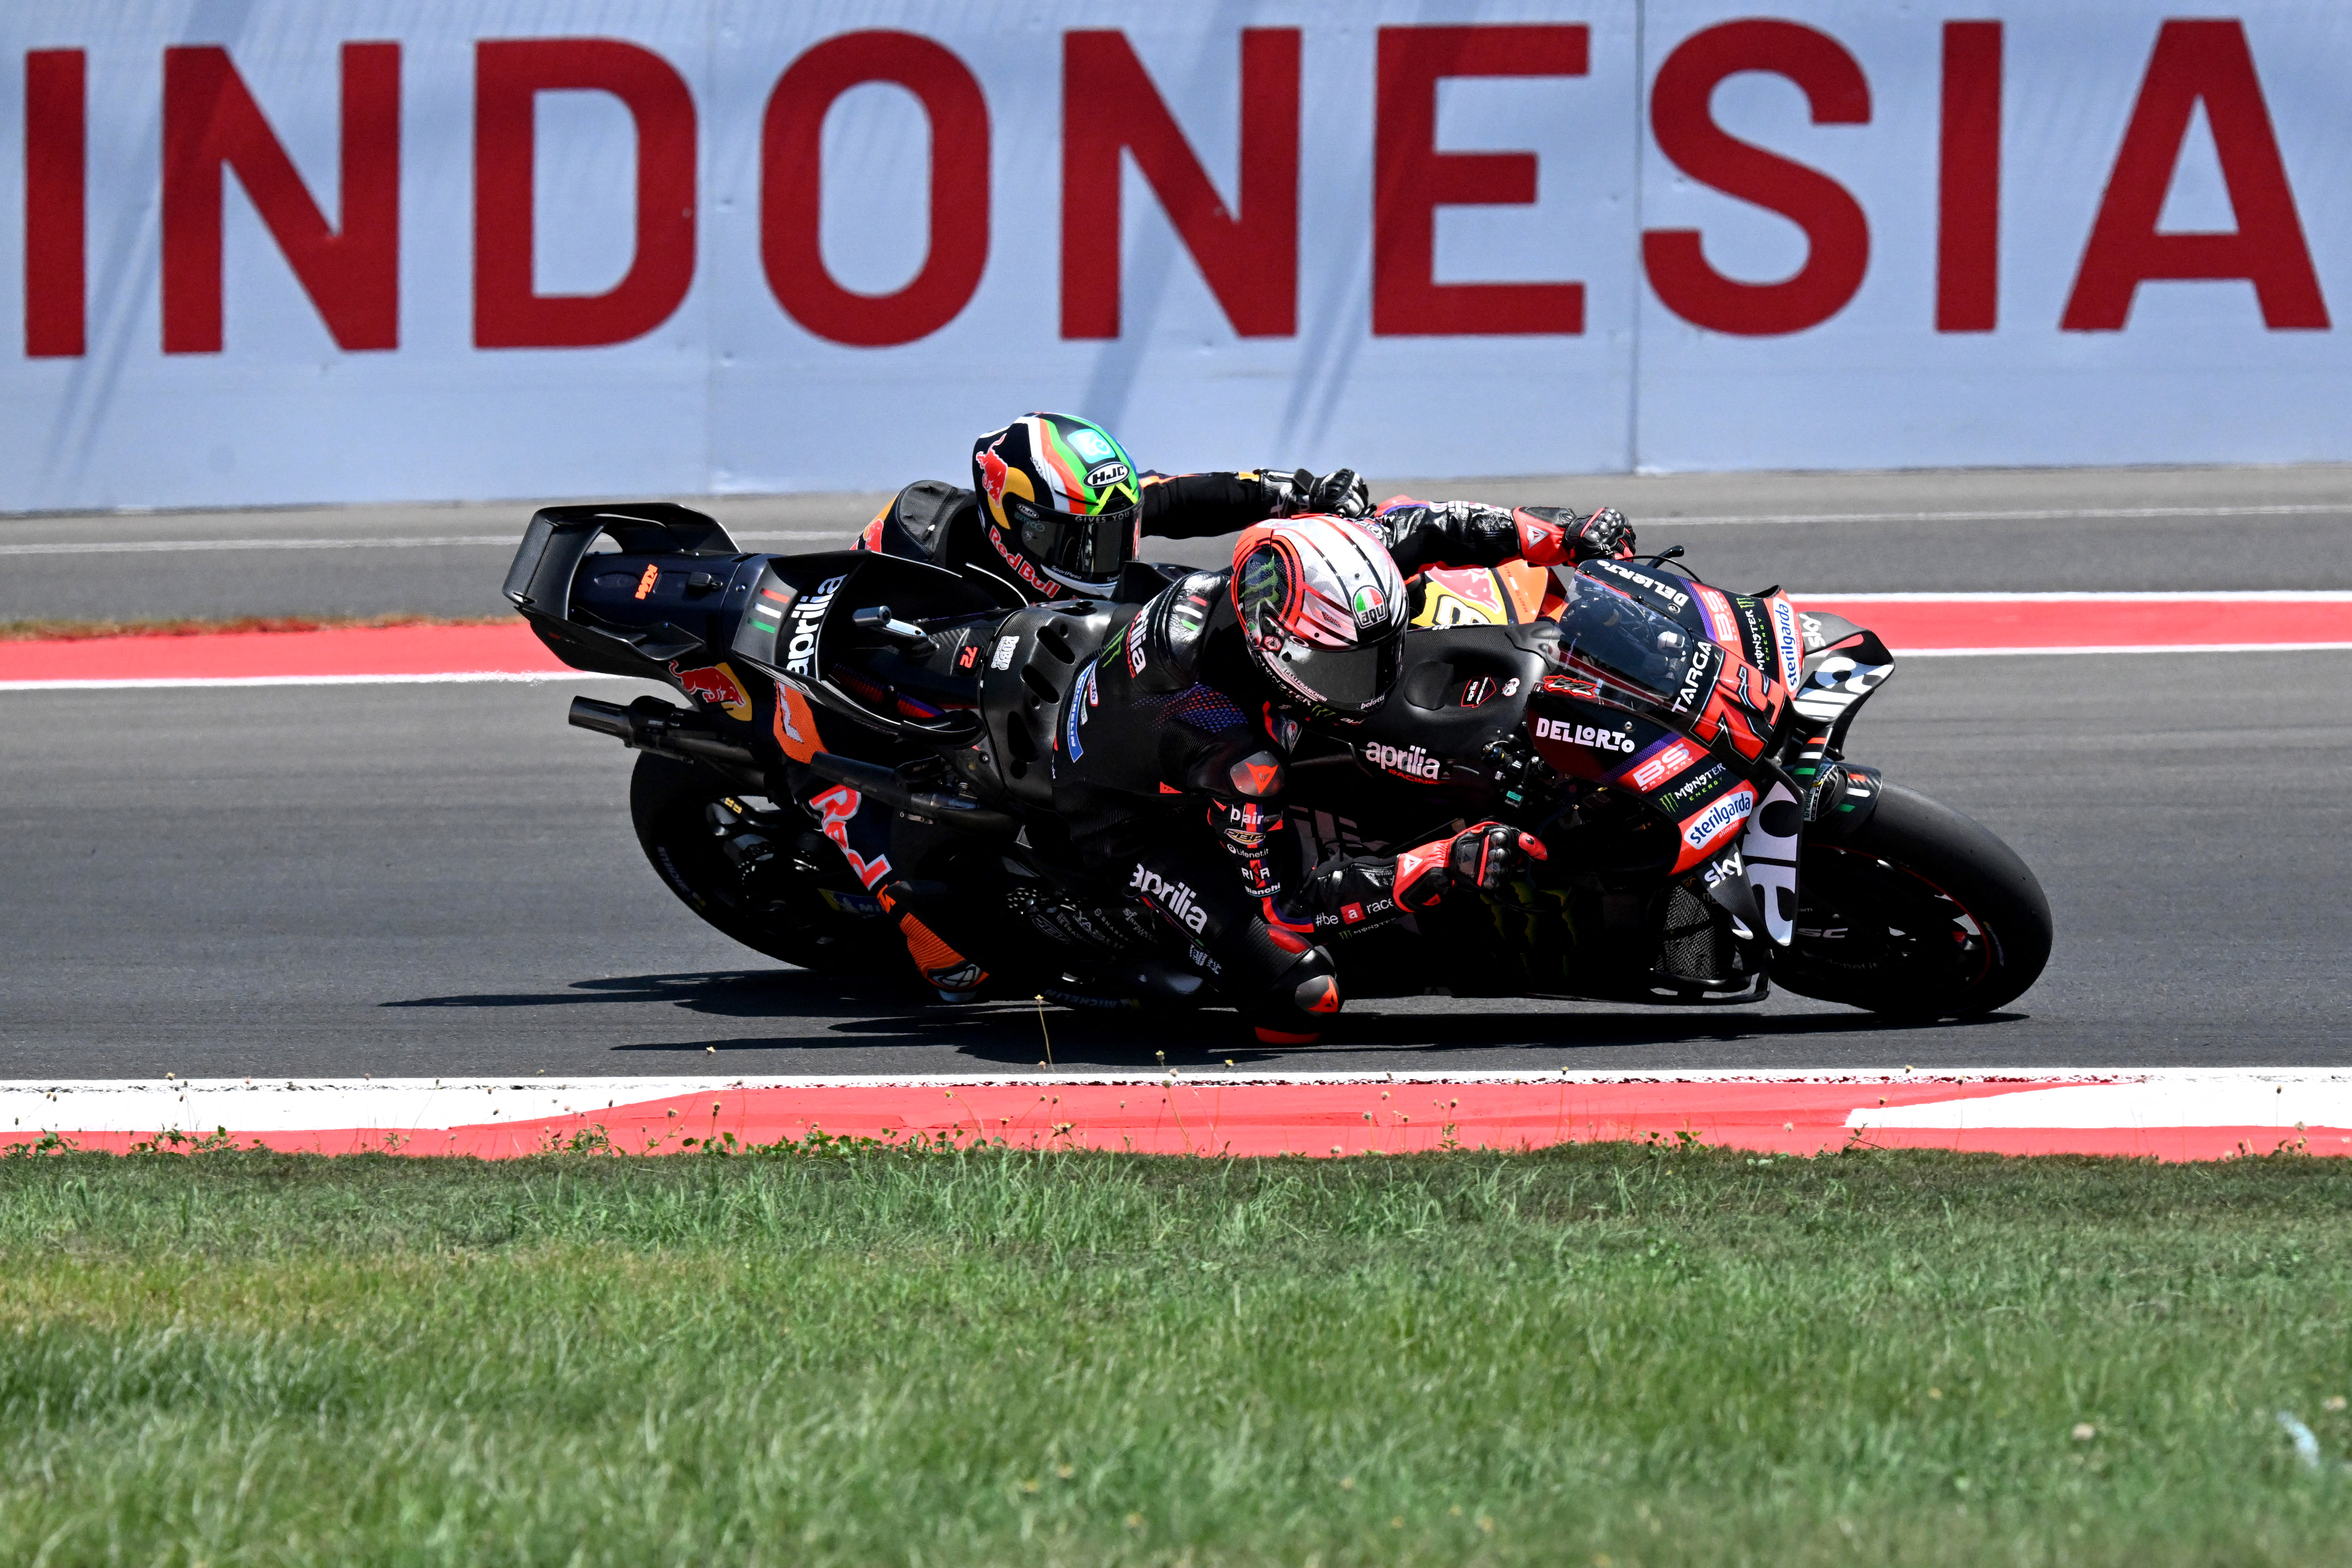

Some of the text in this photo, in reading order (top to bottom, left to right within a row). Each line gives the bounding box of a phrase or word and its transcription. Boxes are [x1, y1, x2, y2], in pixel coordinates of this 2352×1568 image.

[26, 20, 2329, 356] INDONESIA
[1093, 465, 1124, 485] HJC
[1112, 513, 1128, 521] YOU
[989, 525, 1061, 598] Red Bull
[635, 564, 658, 599] KTM
[786, 574, 848, 675] aprilia
[1705, 591, 1733, 641] BS
[959, 646, 978, 669] 72
[1745, 609, 1765, 671] MONSTER
[1758, 617, 1770, 661] ENERGY
[1774, 603, 1799, 686] sterilgarda
[1467, 681, 1478, 701] aprilia
[1671, 641, 1712, 713] TARGA
[1069, 675, 1085, 748] MICHELIN
[1361, 693, 1385, 710] belotti
[1691, 649, 1786, 763] 72
[1365, 741, 1440, 780] aprilia
[1633, 743, 1690, 787] BS
[1674, 762, 1726, 799] MONSTER
[1689, 777, 1723, 801] ENERGY
[1690, 793, 1751, 844] sterilgarda
[1718, 820, 1739, 839] alimenti
[1236, 848, 1269, 859] Lifenet.it
[1704, 852, 1743, 888] sky
[1245, 882, 1281, 895] Bianchi
[1315, 912, 1339, 927] #be
[1348, 908, 1358, 919] a
